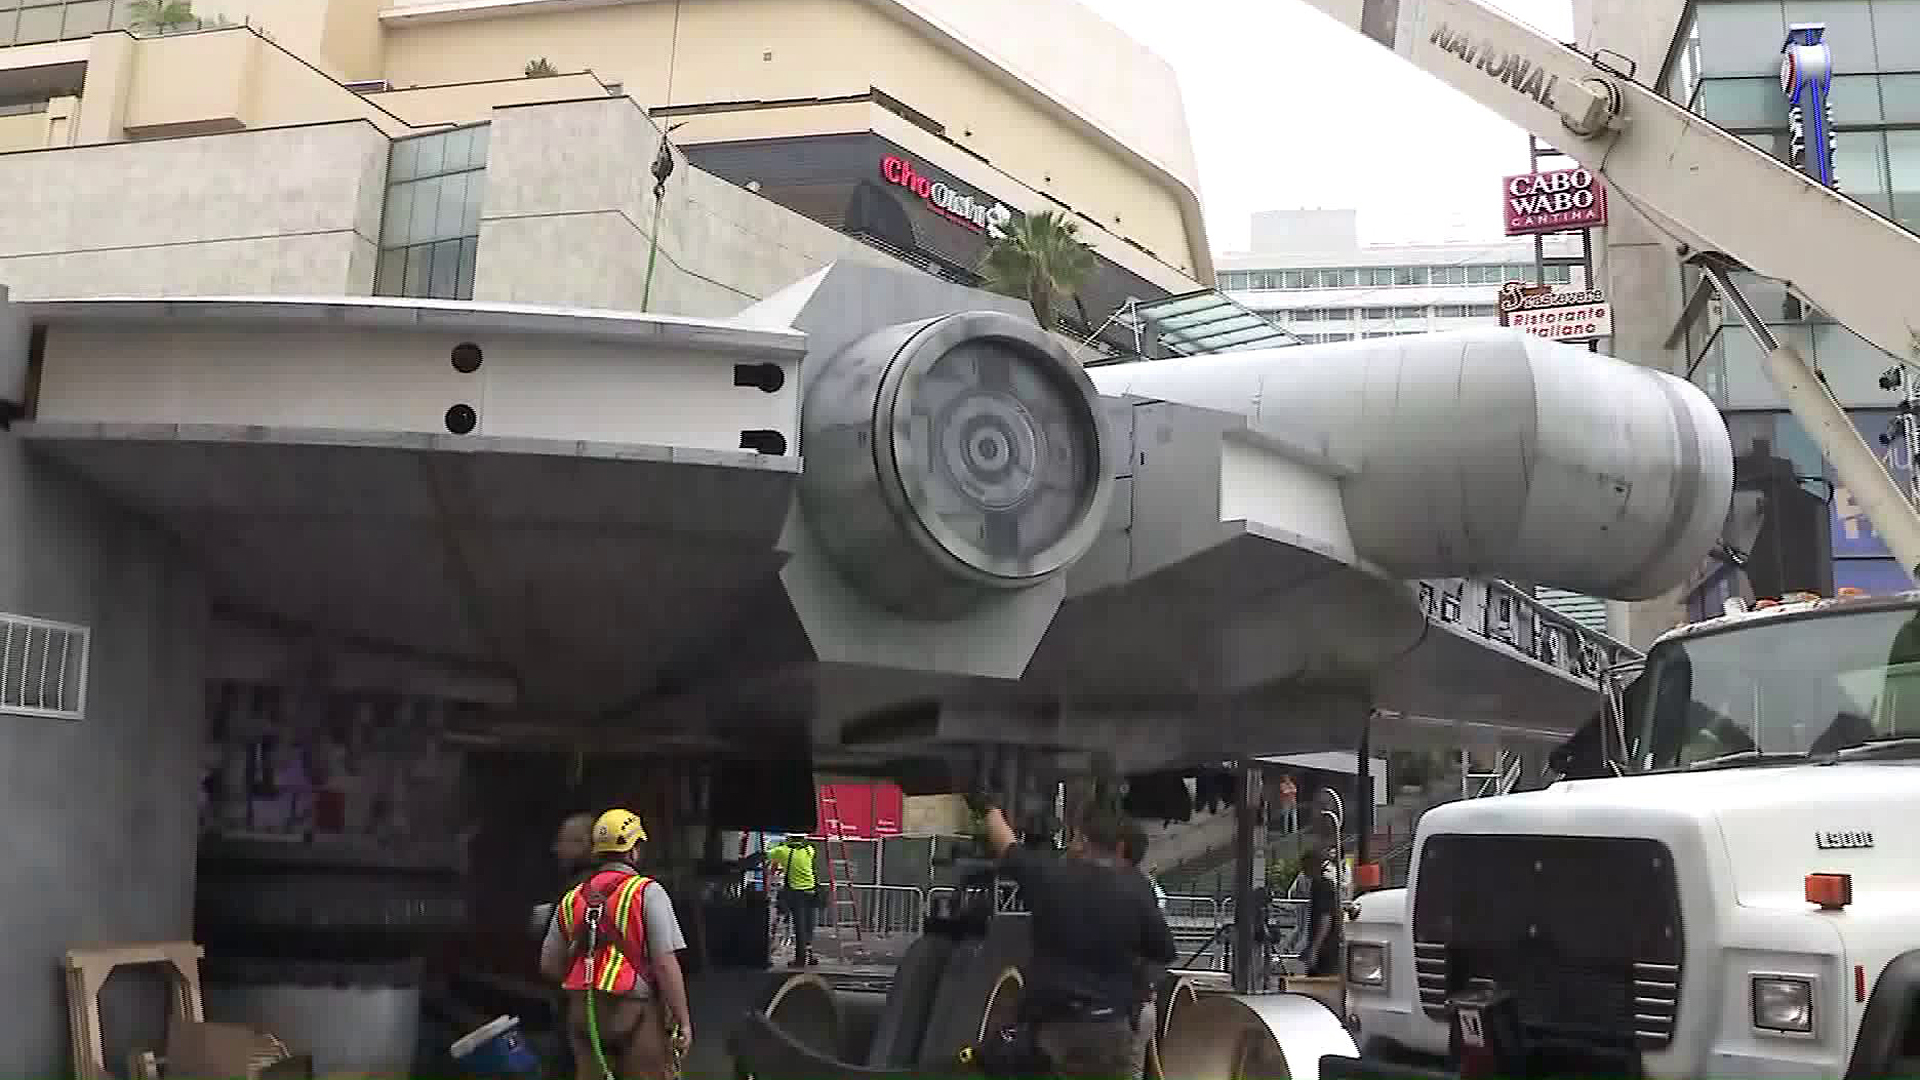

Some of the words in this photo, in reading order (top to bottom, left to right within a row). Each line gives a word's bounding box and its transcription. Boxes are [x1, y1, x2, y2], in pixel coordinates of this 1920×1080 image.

[1430, 23, 1559, 109] NATIONAL
[1509, 169, 1593, 197] CABO
[1509, 189, 1594, 215] WABO
[1511, 209, 1594, 226] CANTINA
[1513, 308, 1605, 325] Ristorante
